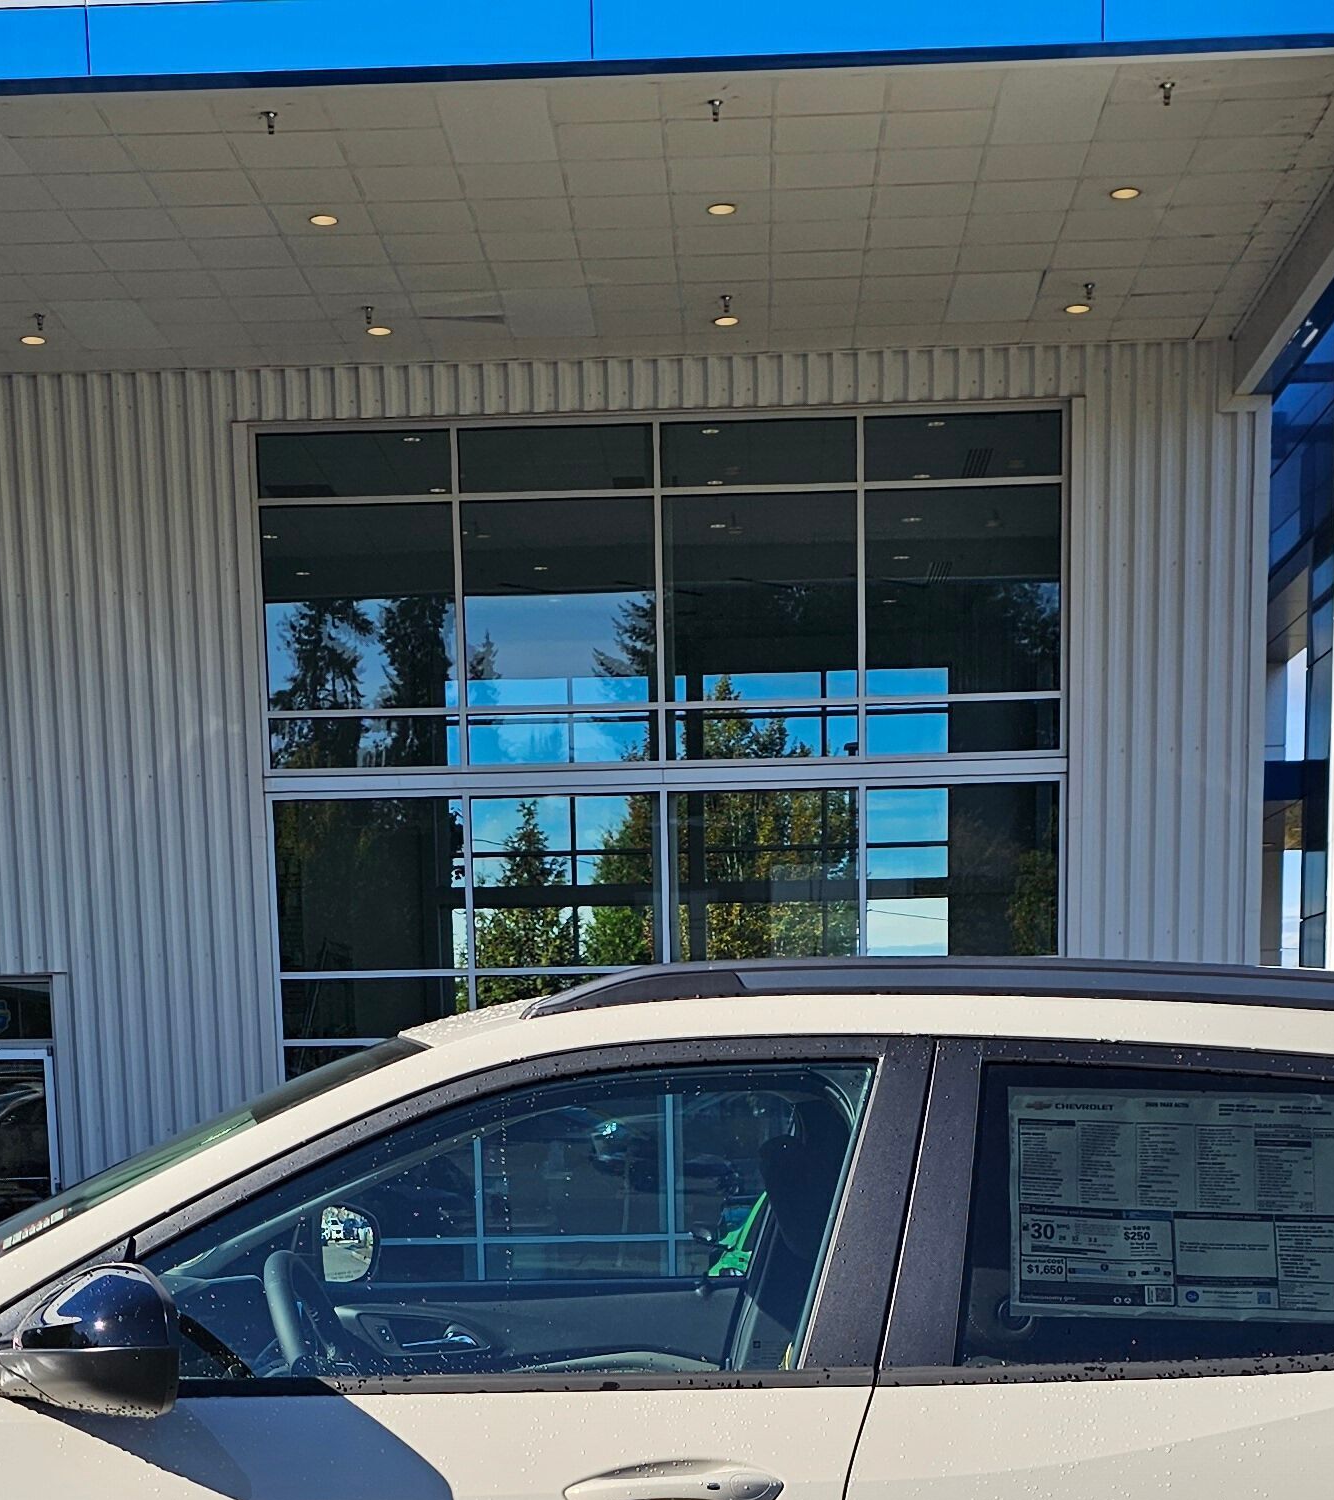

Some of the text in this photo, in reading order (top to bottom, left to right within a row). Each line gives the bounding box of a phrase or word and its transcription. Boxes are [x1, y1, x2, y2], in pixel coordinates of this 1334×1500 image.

[1055, 1102, 1115, 1111] CHEVROLET
[1031, 1222, 1055, 1240] 30
[1123, 1231, 1151, 1241] $250
[1026, 1264, 1063, 1275] $1,650
